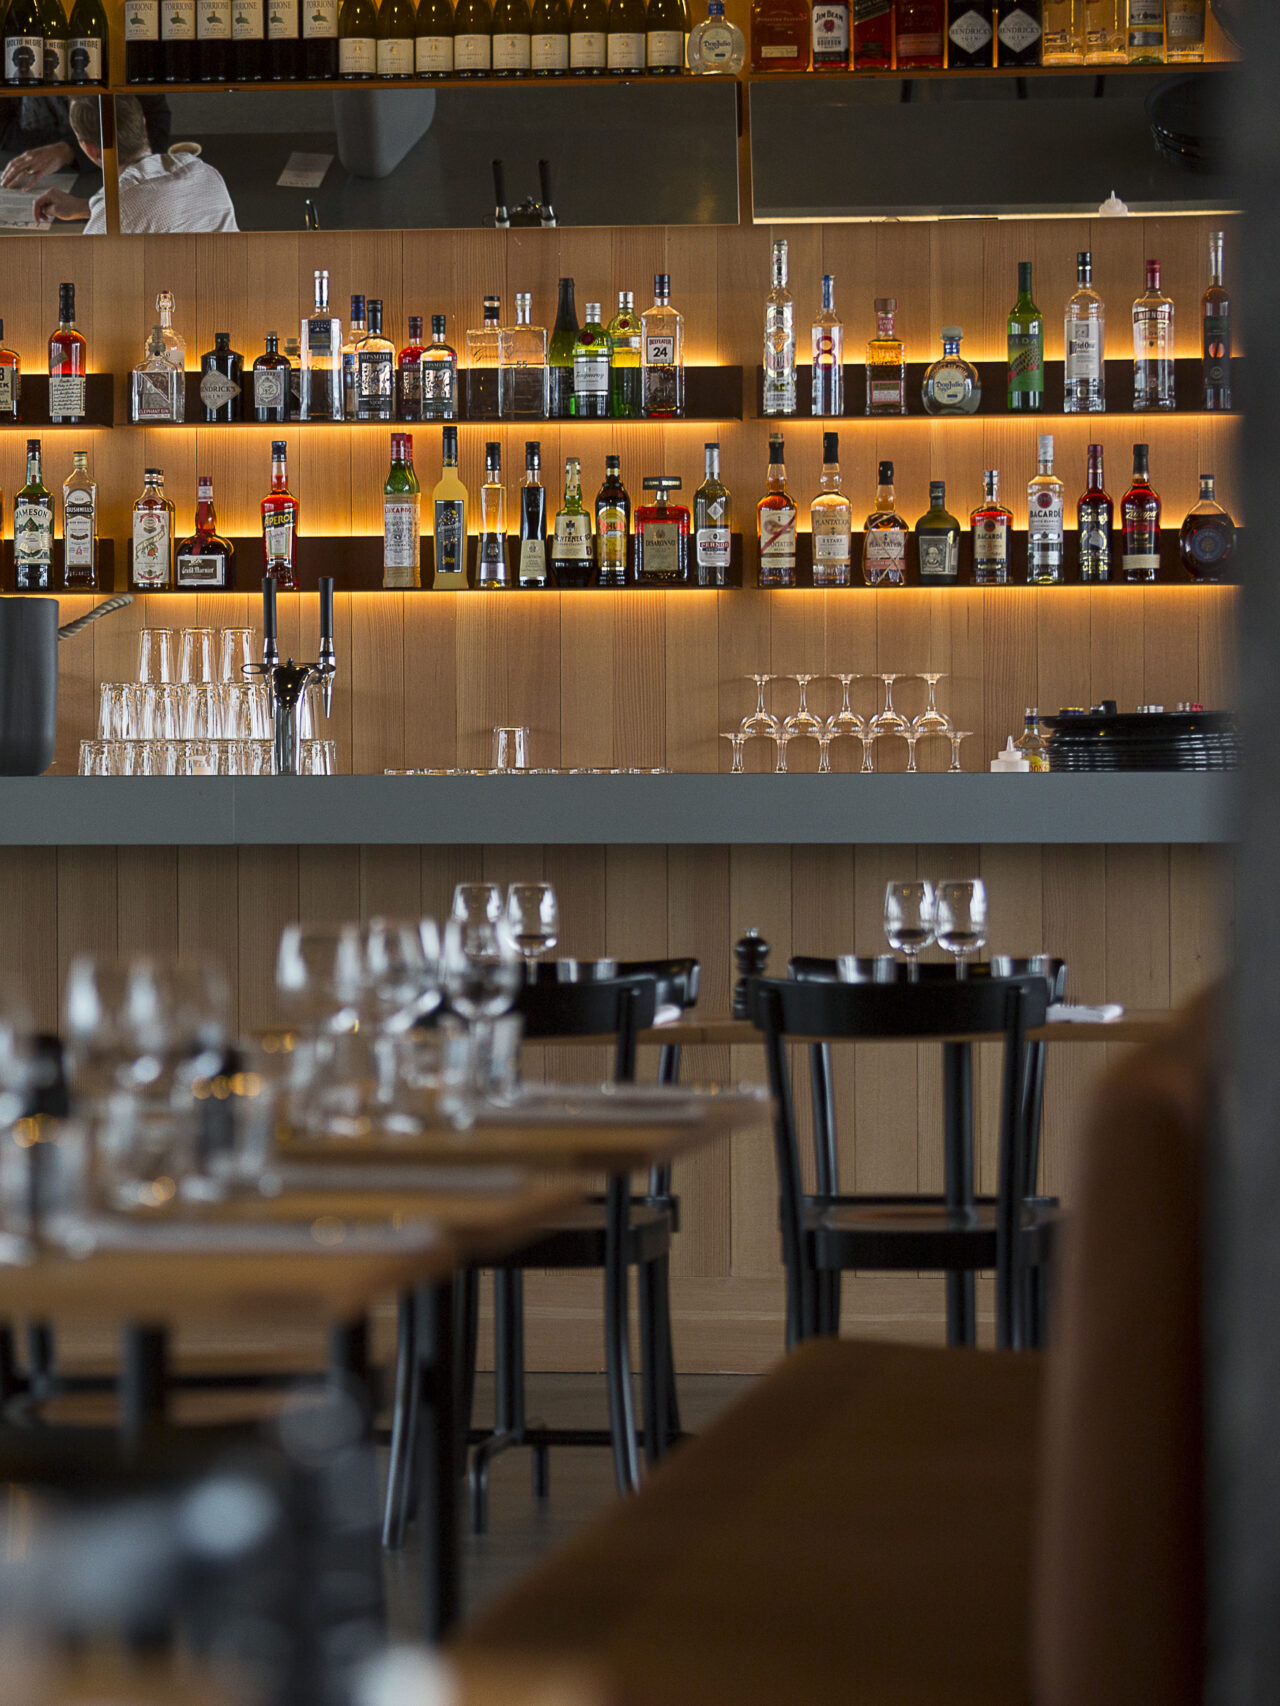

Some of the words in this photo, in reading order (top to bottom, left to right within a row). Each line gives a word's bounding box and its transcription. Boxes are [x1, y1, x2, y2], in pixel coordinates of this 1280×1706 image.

[166, 2, 193, 11] TORRIONE
[201, 1, 229, 10] TORRIONE
[306, 0, 336, 9] TORRIONE
[814, 12, 826, 23] JIM
[826, 10, 844, 22] BEAM
[951, 27, 992, 35] HENDRICK'S
[24, 38, 42, 48] NEGRE
[653, 346, 668, 358] 24
[200, 385, 236, 393] ENDRICK'S
[15, 507, 48, 519] JAMESON
[264, 514, 294, 526] APEROL
[645, 539, 676, 547] DISARONNO
[194, 566, 214, 574] Marnier
